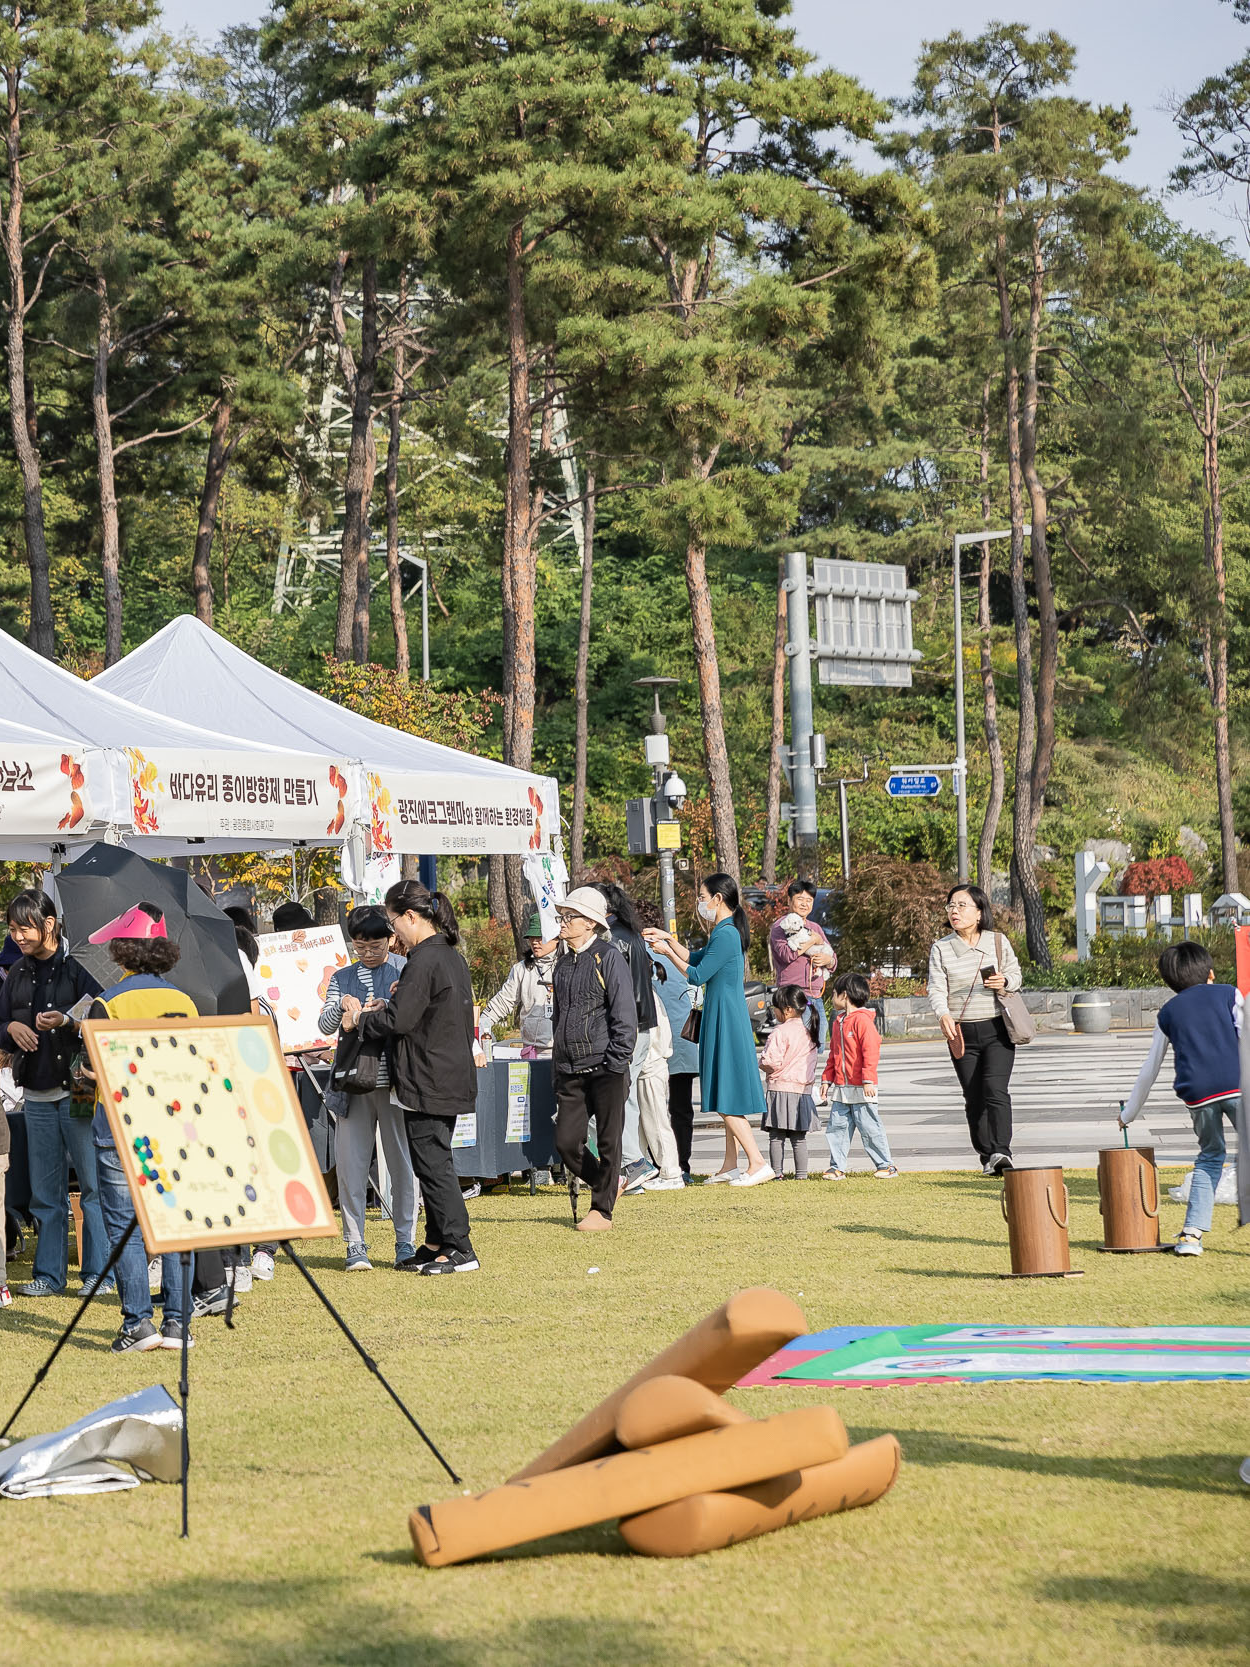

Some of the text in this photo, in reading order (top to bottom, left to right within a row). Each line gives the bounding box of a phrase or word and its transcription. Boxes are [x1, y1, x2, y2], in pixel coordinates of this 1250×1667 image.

[169, 772, 319, 806] 바다유리 종이방향제 만들기
[397, 799, 534, 827] 광진에코그랜마와 함께하는 환경체험
